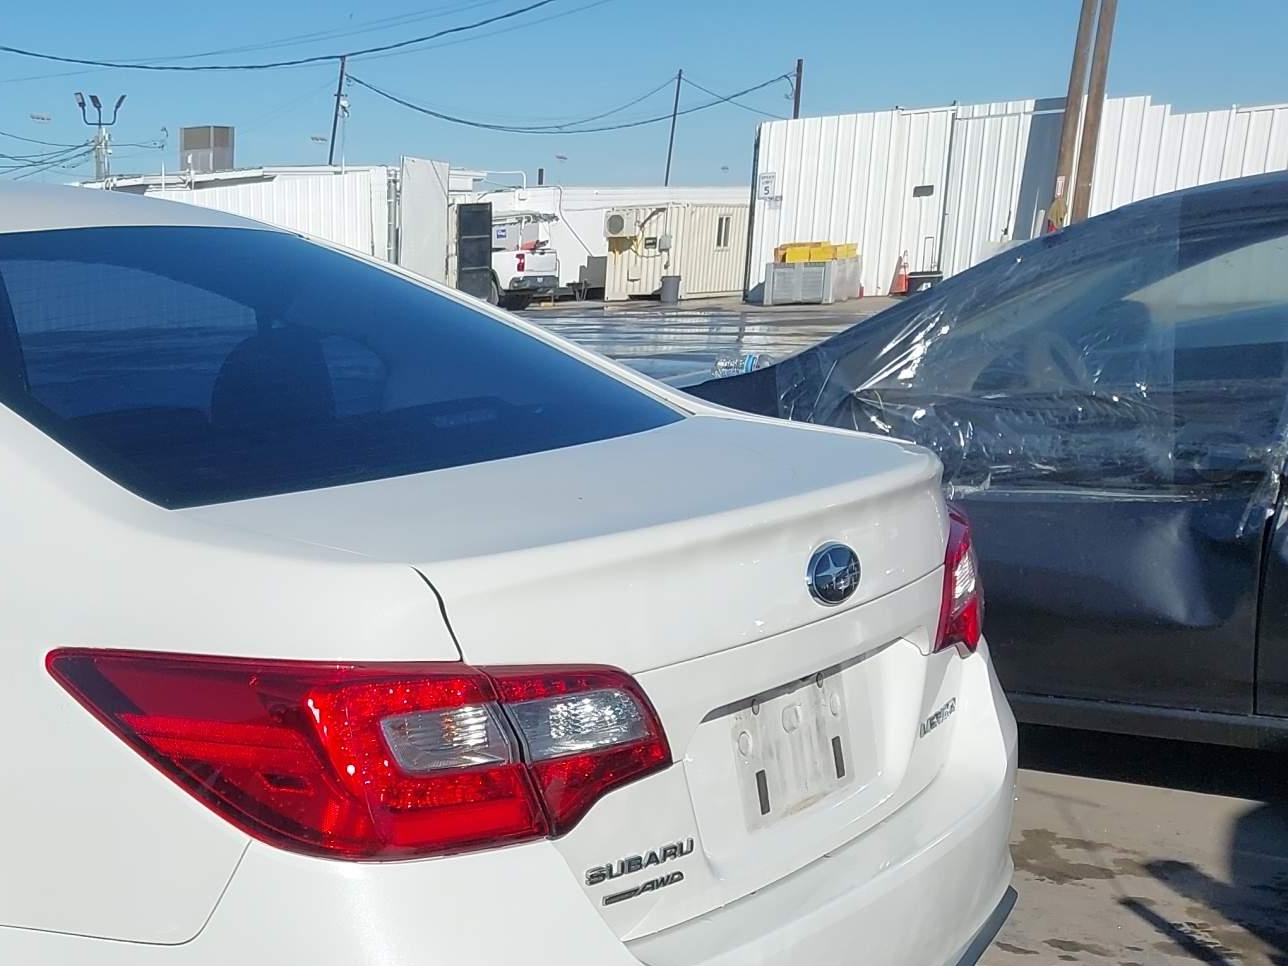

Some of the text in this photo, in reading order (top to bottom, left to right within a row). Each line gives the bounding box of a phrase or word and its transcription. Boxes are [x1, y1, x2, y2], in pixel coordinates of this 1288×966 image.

[764, 186, 770, 196] 5
[585, 837, 694, 886] SUBARU
[638, 871, 684, 895] AWD
